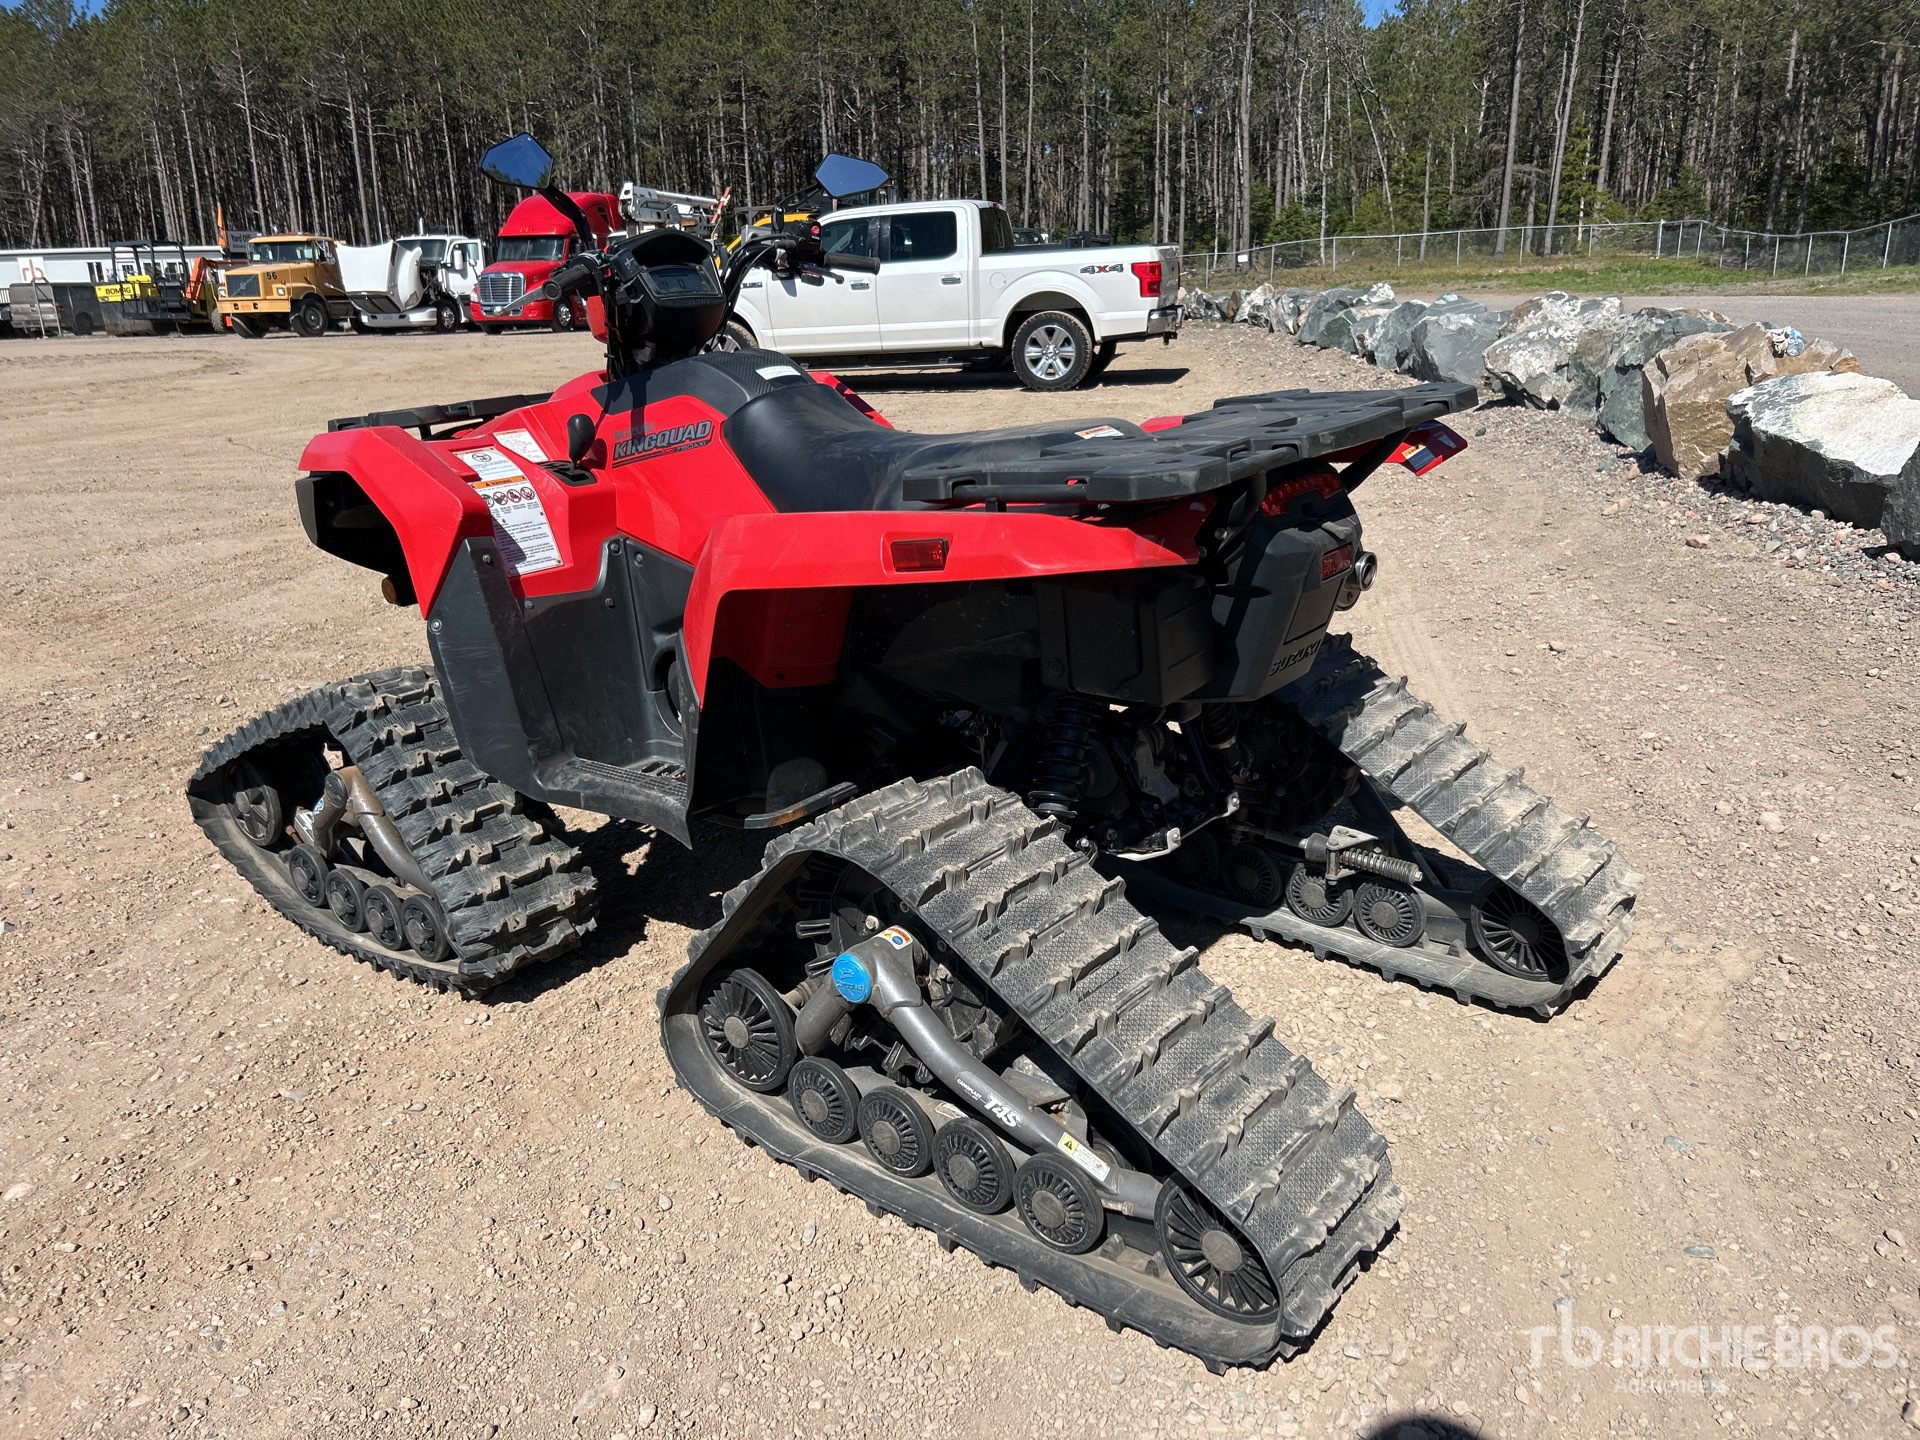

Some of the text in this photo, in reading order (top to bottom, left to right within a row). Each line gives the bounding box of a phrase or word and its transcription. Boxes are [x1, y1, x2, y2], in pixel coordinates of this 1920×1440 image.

[266, 271, 277, 280] 56
[614, 421, 656, 440] SUZUKI
[614, 420, 712, 460] KINGQUAD
[1269, 639, 1322, 677] SUZUKI
[984, 1095, 1022, 1128] T4S
